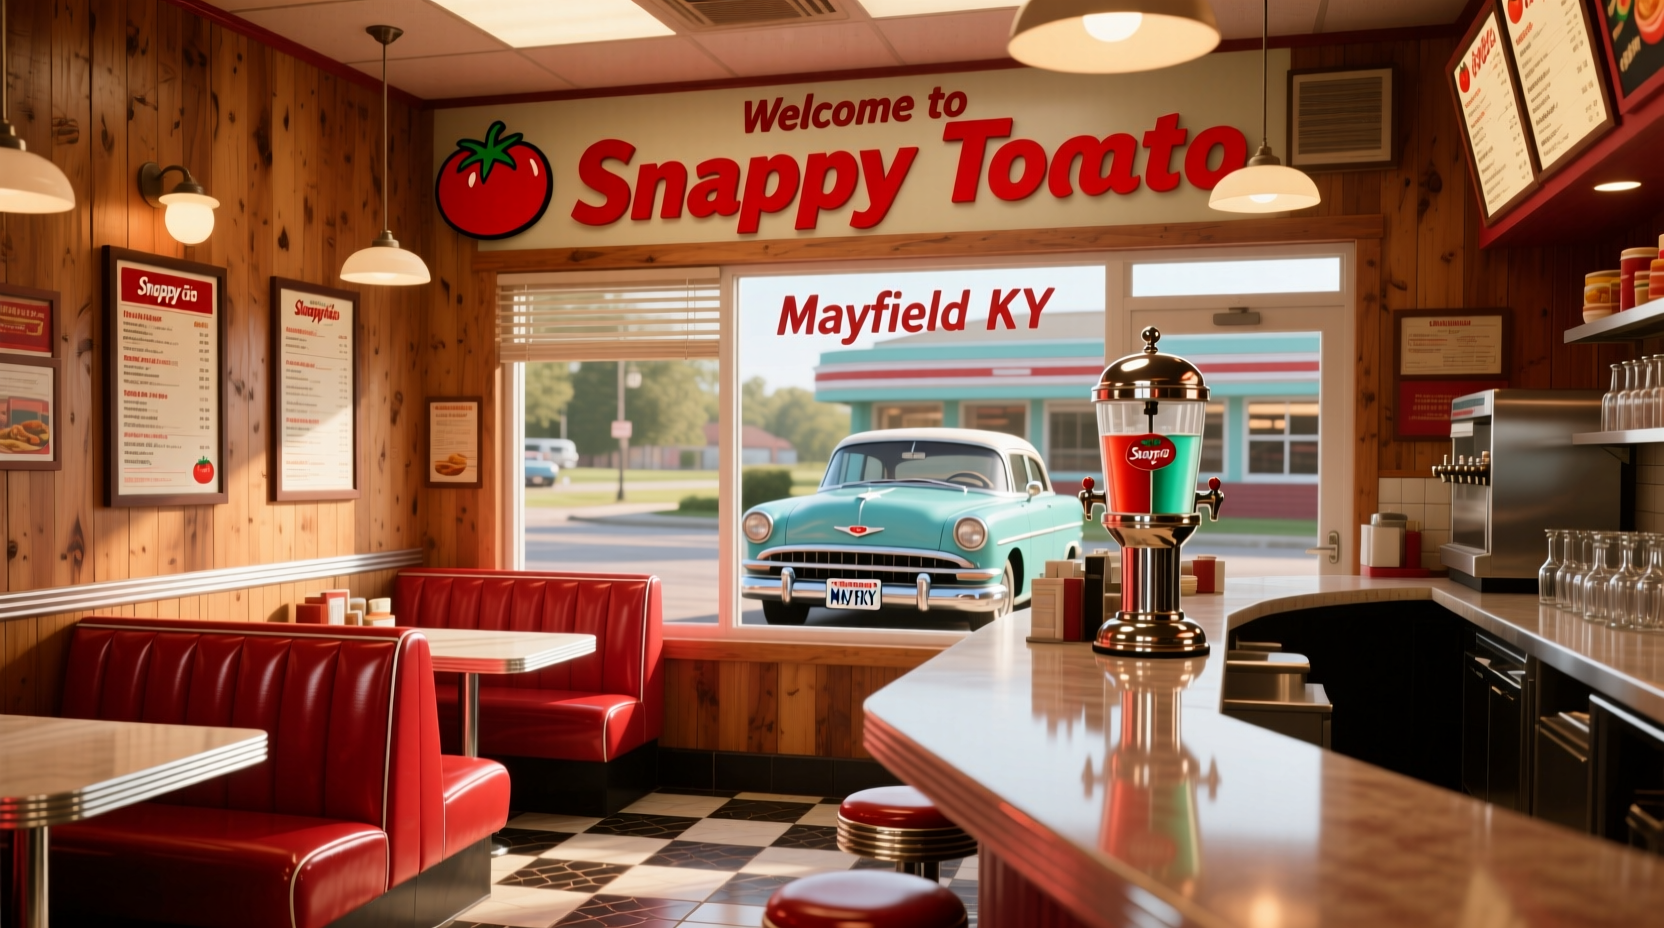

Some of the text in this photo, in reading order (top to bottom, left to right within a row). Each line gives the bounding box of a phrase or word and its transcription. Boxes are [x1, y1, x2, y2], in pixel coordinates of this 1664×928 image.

[744, 87, 968, 135] Welcome to
[571, 138, 919, 234] Snappy
[777, 288, 1055, 346] Mayfield KY
